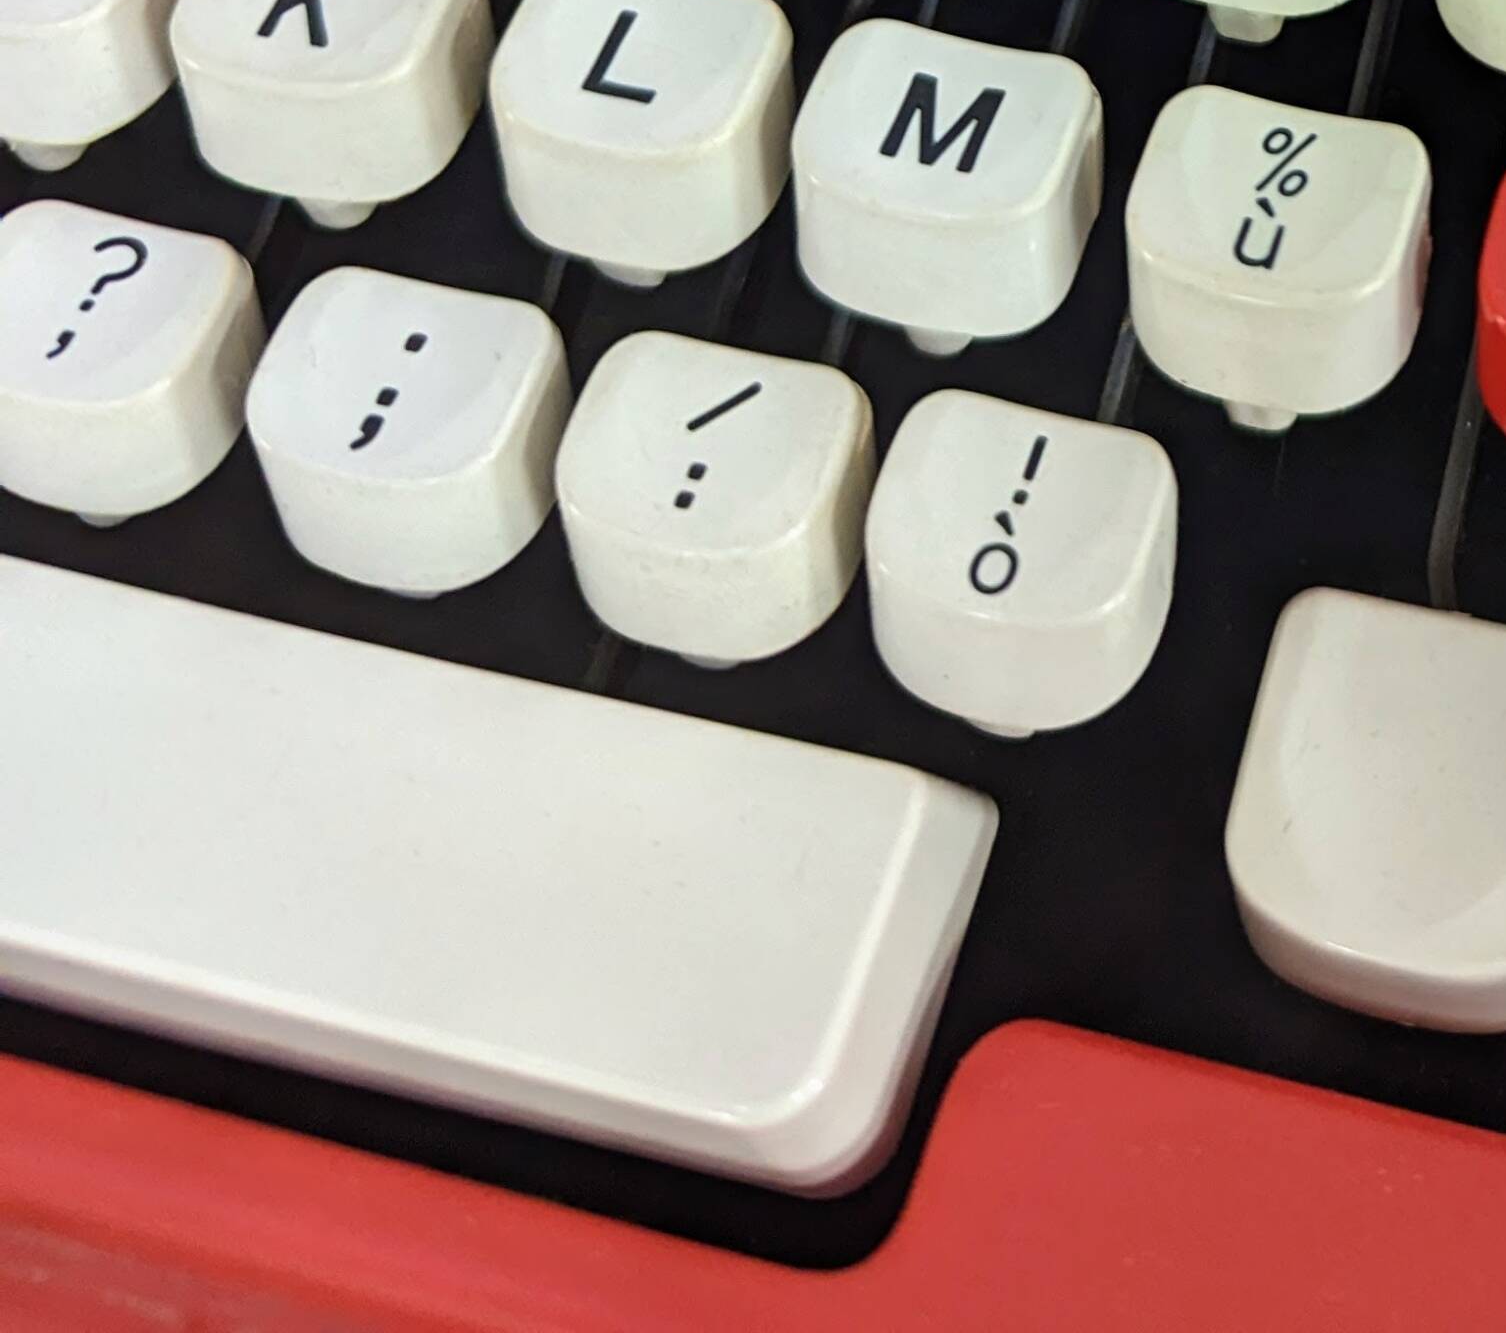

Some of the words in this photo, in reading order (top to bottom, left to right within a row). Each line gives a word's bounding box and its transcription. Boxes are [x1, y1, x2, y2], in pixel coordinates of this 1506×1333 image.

[581, 10, 656, 105] L
[879, 72, 1006, 174] M
[1255, 127, 1318, 199] %
[1233, 197, 1285, 270] ù
[78, 236, 148, 312] ?
[686, 382, 762, 432] /
[1012, 435, 1048, 506] !
